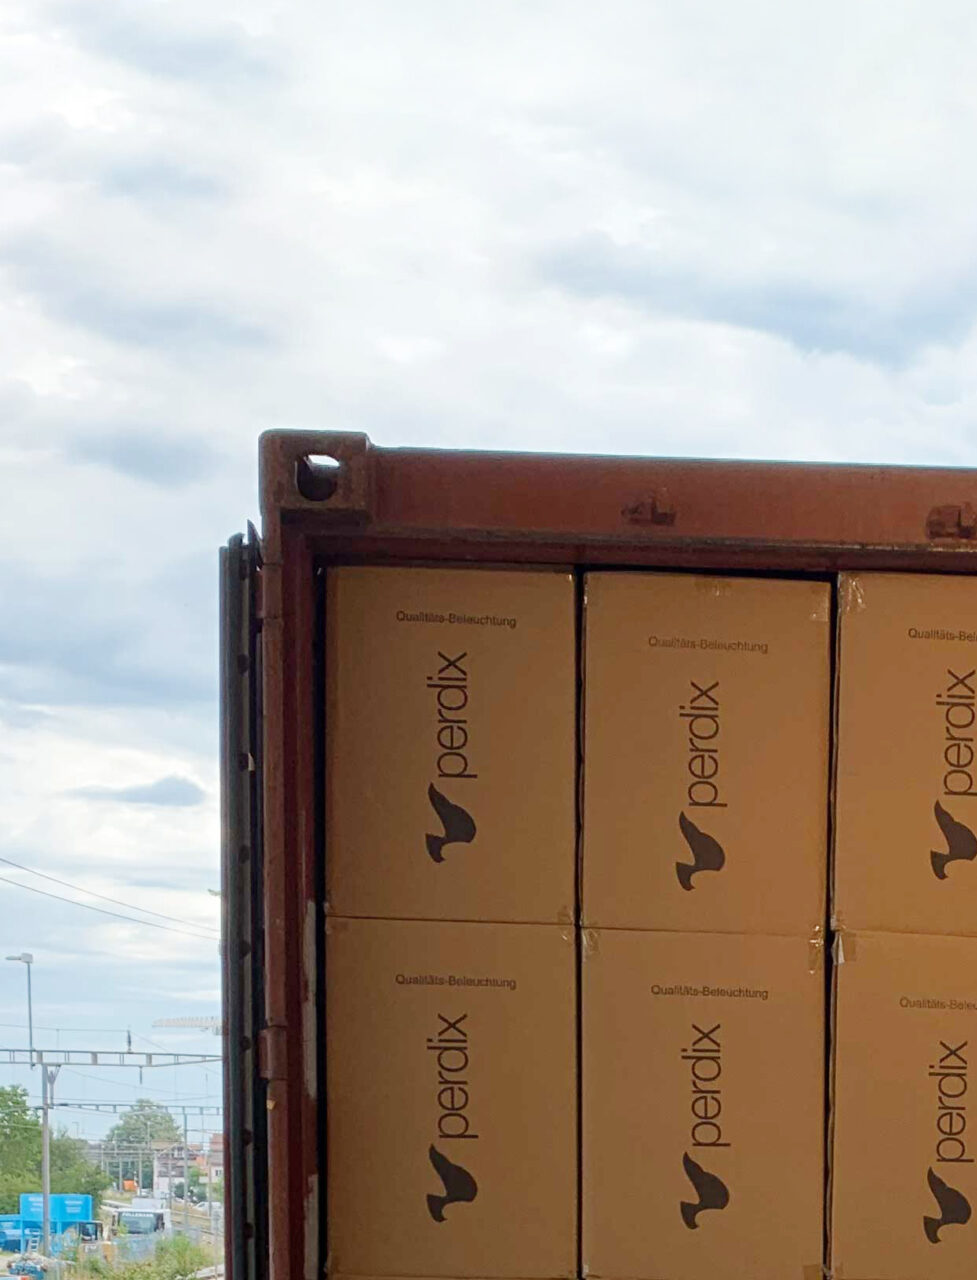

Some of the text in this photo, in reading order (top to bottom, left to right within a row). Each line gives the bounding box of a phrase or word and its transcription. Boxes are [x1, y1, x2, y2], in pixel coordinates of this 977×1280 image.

[395, 610, 517, 630] Qualitäts-Beleuchtung
[427, 652, 478, 780] perdix
[679, 682, 727, 807] perdix
[650, 984, 769, 1001] Qualitäts-Beleuchtung
[427, 1014, 479, 1140] perdix
[681, 1024, 731, 1149] perdix
[928, 1041, 974, 1164] perdix
